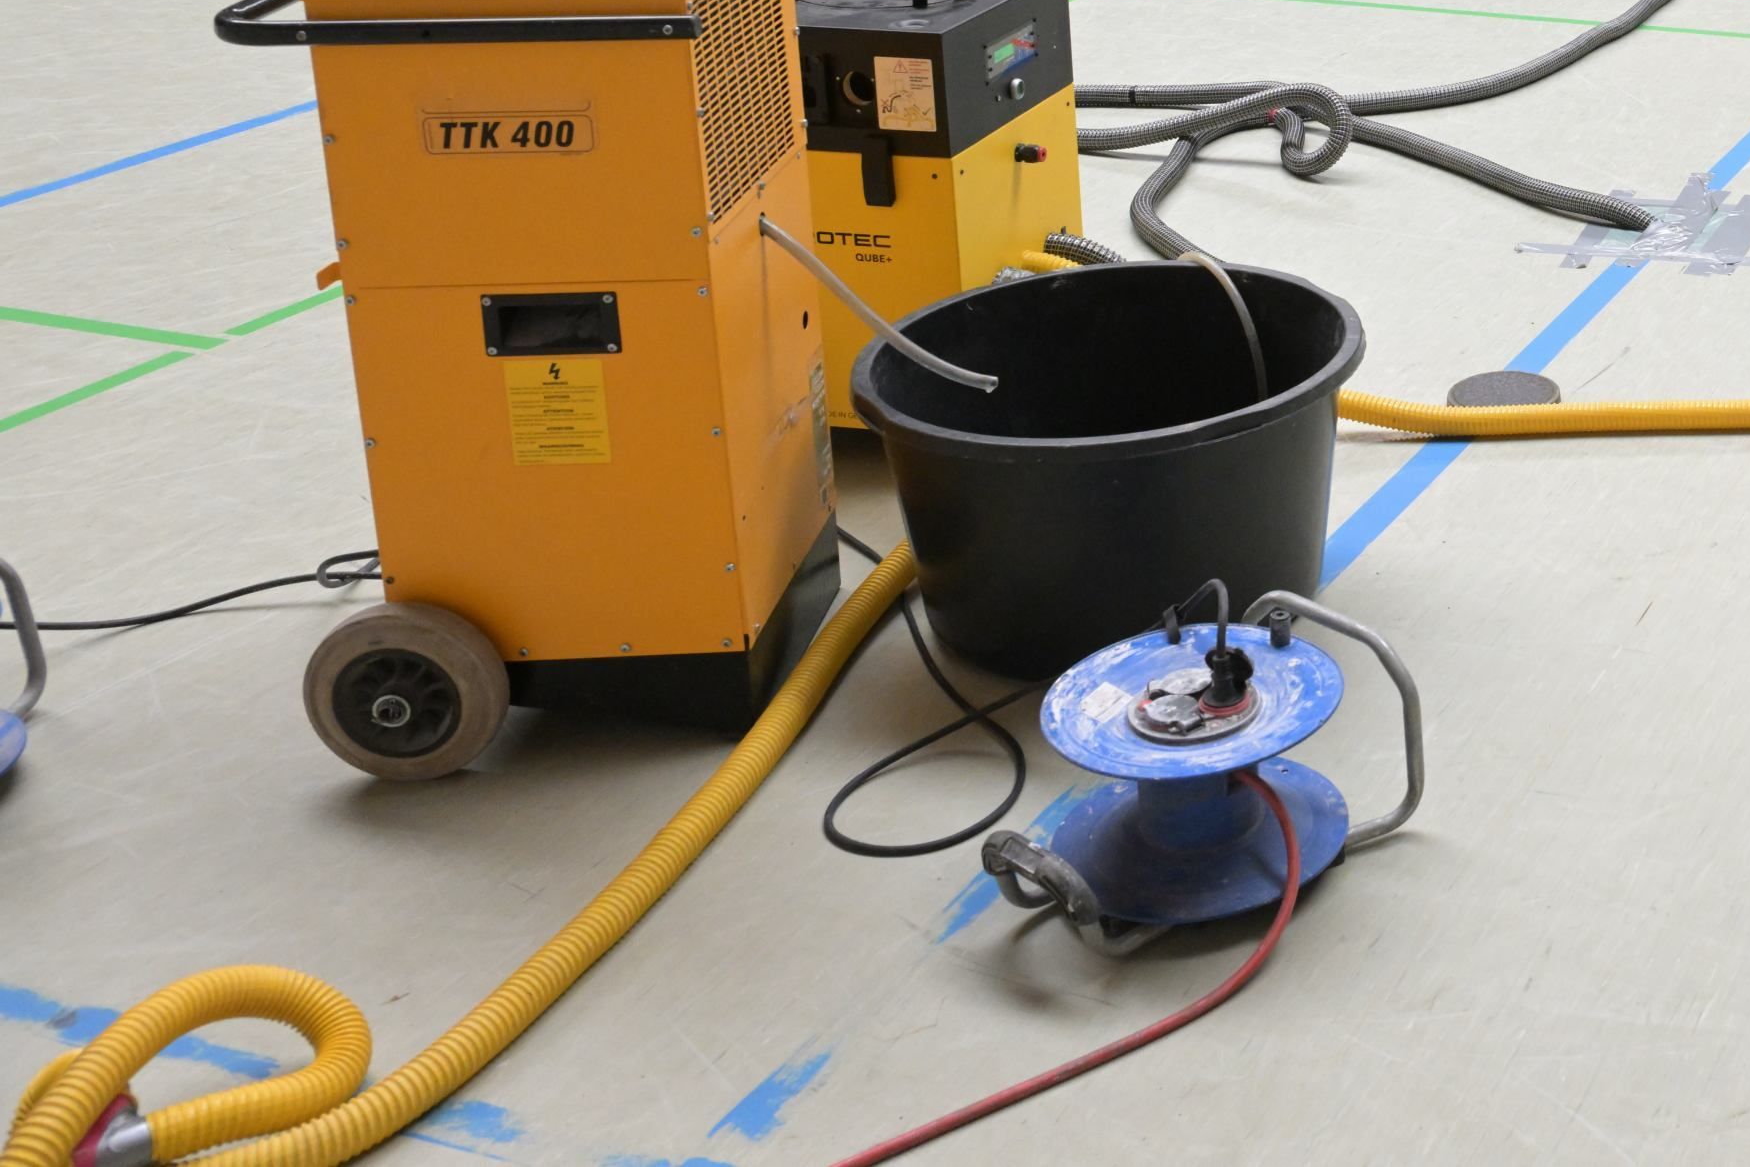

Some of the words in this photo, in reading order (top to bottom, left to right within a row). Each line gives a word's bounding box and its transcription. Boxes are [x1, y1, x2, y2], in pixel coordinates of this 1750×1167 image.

[440, 121, 501, 149] TTK
[510, 120, 575, 148] 400
[814, 230, 892, 248] OTEC
[855, 253, 893, 263] QUBE+
